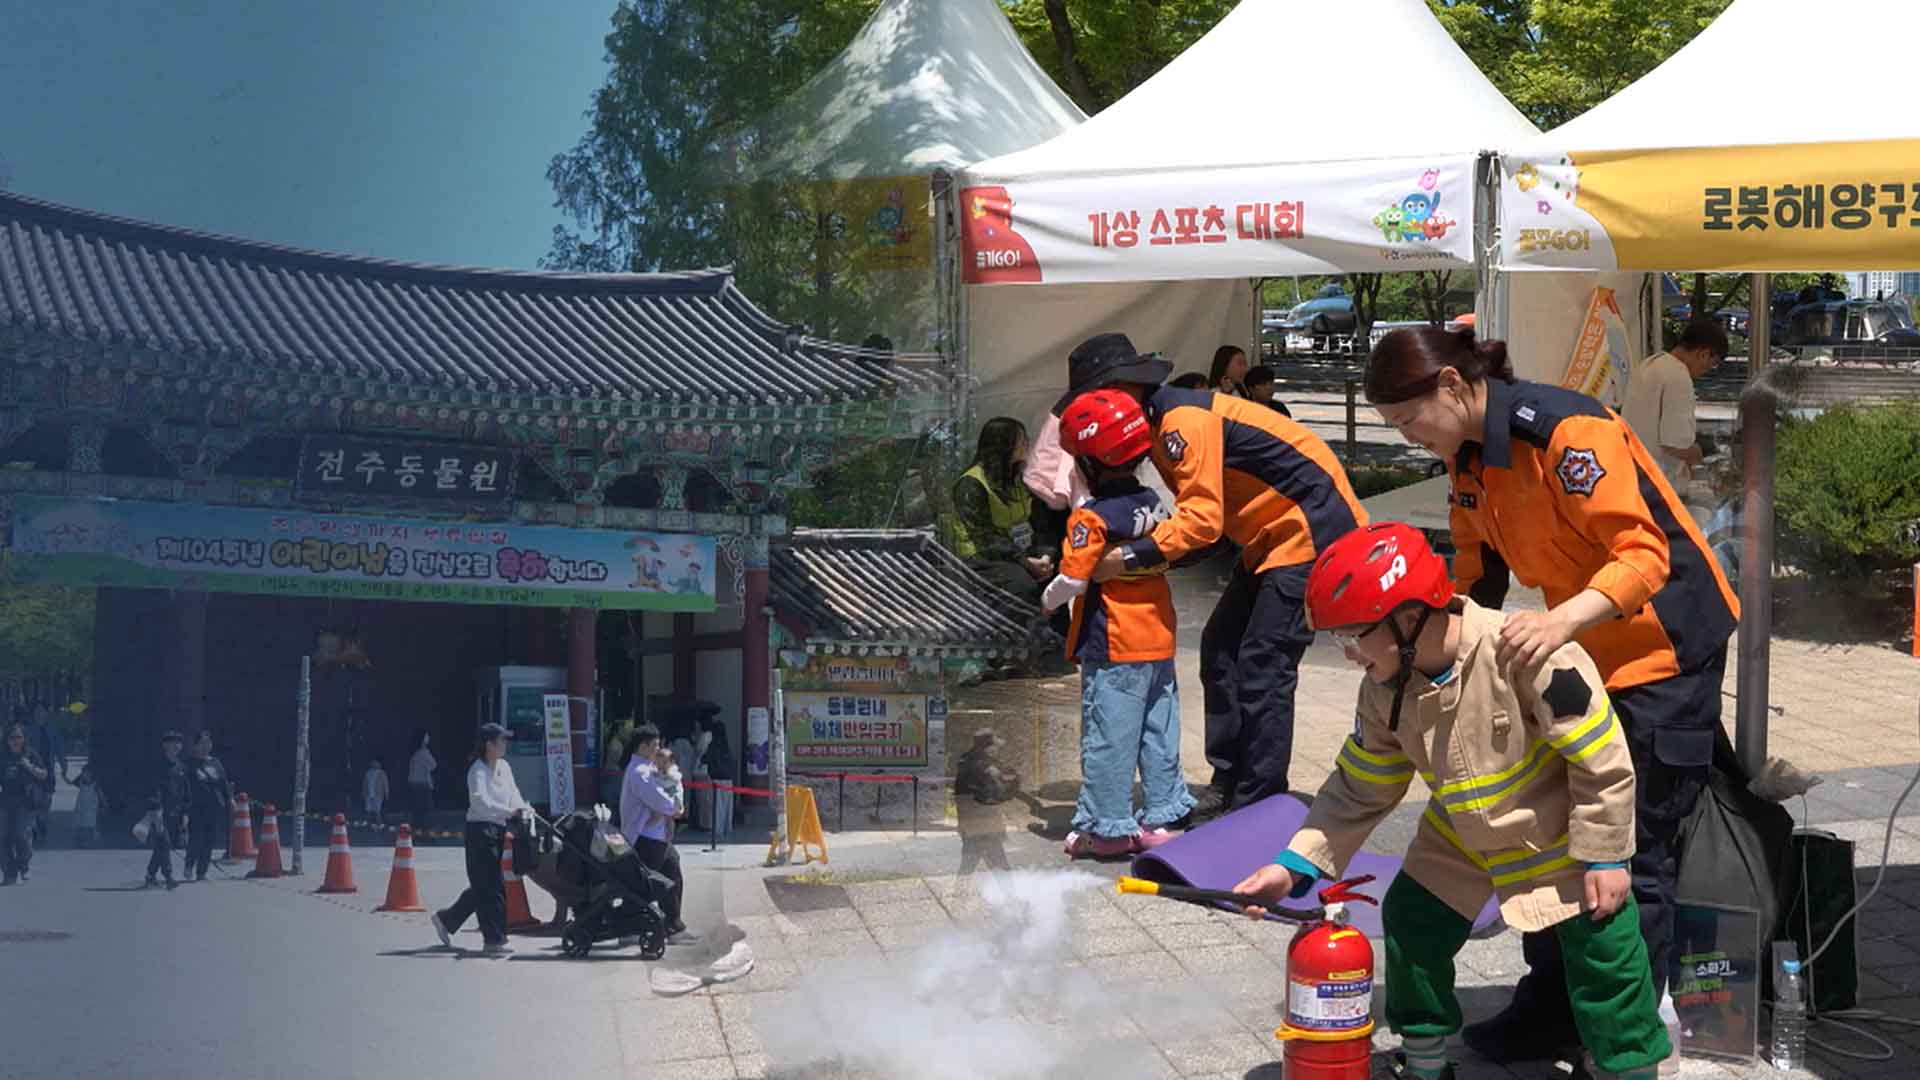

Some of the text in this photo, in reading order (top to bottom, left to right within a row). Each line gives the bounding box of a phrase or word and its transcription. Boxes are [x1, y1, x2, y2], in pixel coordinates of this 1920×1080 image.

[1088, 201, 1305, 248] 가상 스포츠 대회
[316, 448, 498, 492] 전주동물원
[156, 536, 609, 583] 제104주년 어린이날을 진심으로 축하합니다
